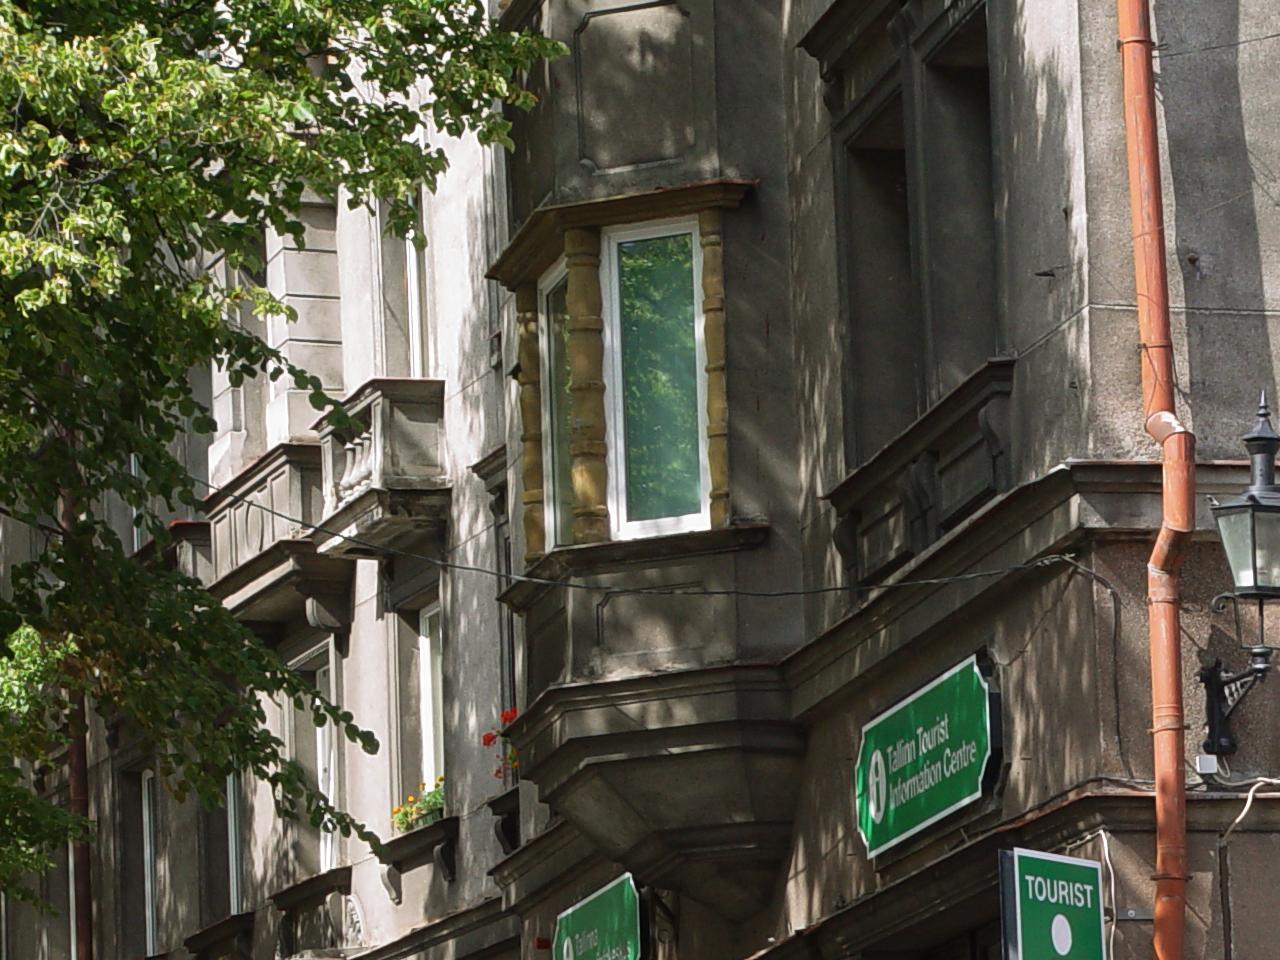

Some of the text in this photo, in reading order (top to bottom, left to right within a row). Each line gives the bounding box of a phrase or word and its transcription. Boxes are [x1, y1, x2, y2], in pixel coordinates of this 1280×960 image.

[886, 712, 950, 774] Tallinn Tourist
[889, 739, 977, 808] Information Centre
[1025, 874, 1094, 909] TOURIST
